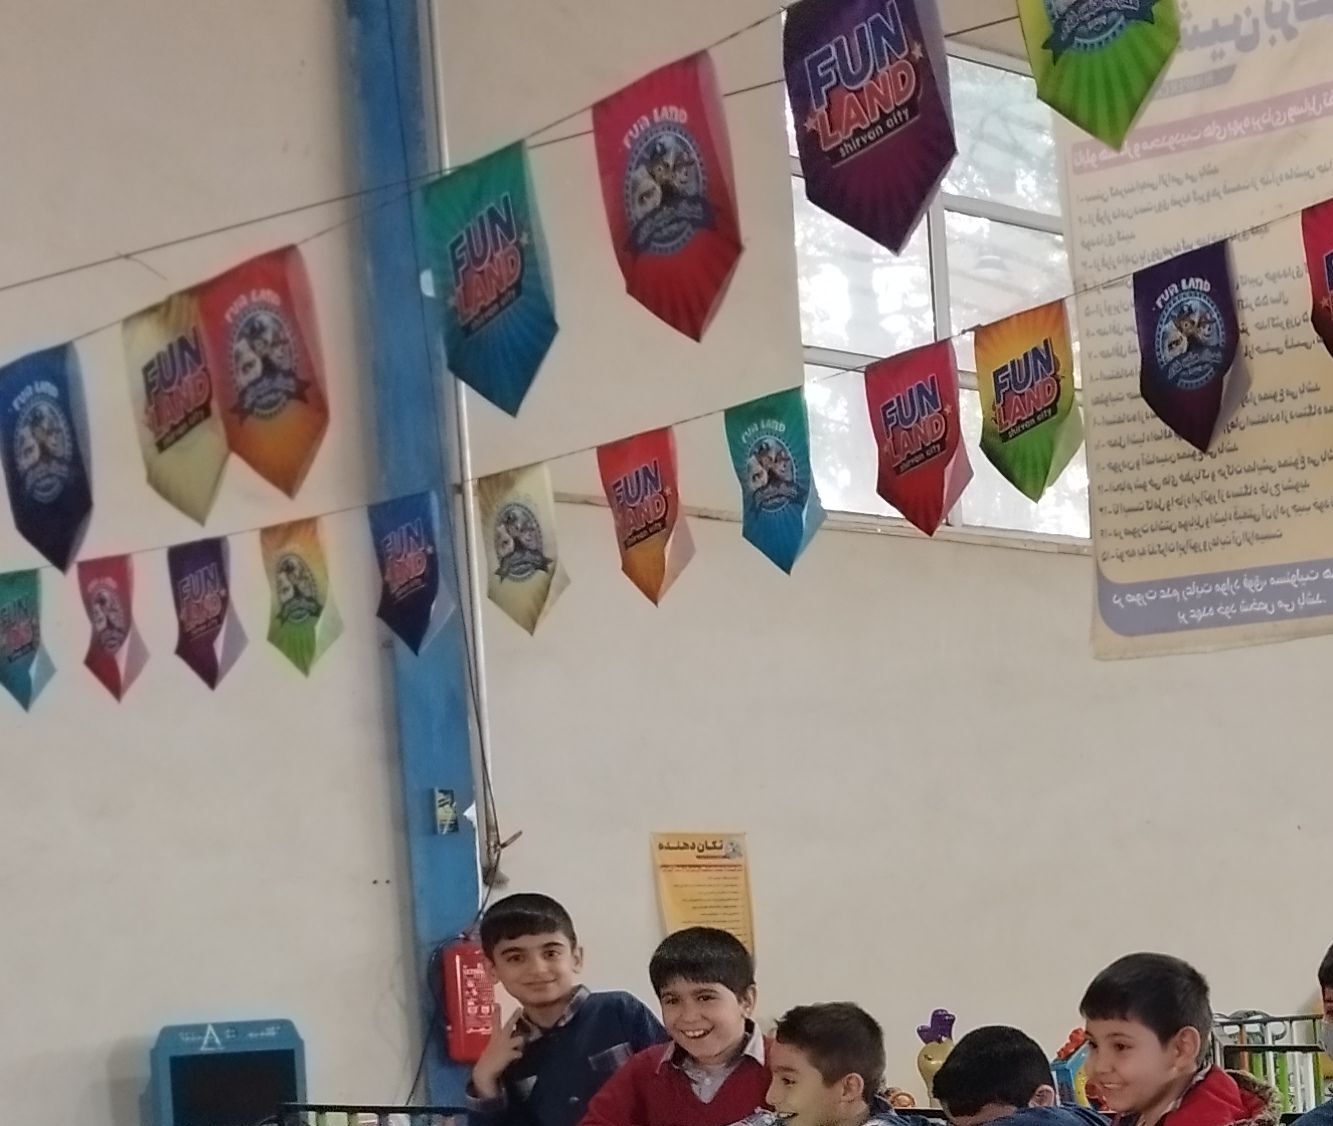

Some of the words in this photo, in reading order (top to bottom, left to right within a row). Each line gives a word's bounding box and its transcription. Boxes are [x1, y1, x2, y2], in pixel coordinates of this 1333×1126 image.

[804, 1, 909, 112] FUN
[816, 60, 918, 152] LAND
[838, 120, 885, 159] shirvan
[886, 107, 909, 137] city
[449, 191, 518, 274] FUN
[454, 244, 522, 316] LAND
[142, 326, 204, 392] FUN
[993, 337, 1055, 404] FUN
[880, 374, 942, 440] FUN
[888, 410, 946, 465] LAND
[997, 377, 1059, 434] LAND
[1008, 418, 1035, 439] shirvan
[613, 461, 660, 506] FUN
[657, 839, 696, 852] دهنده
